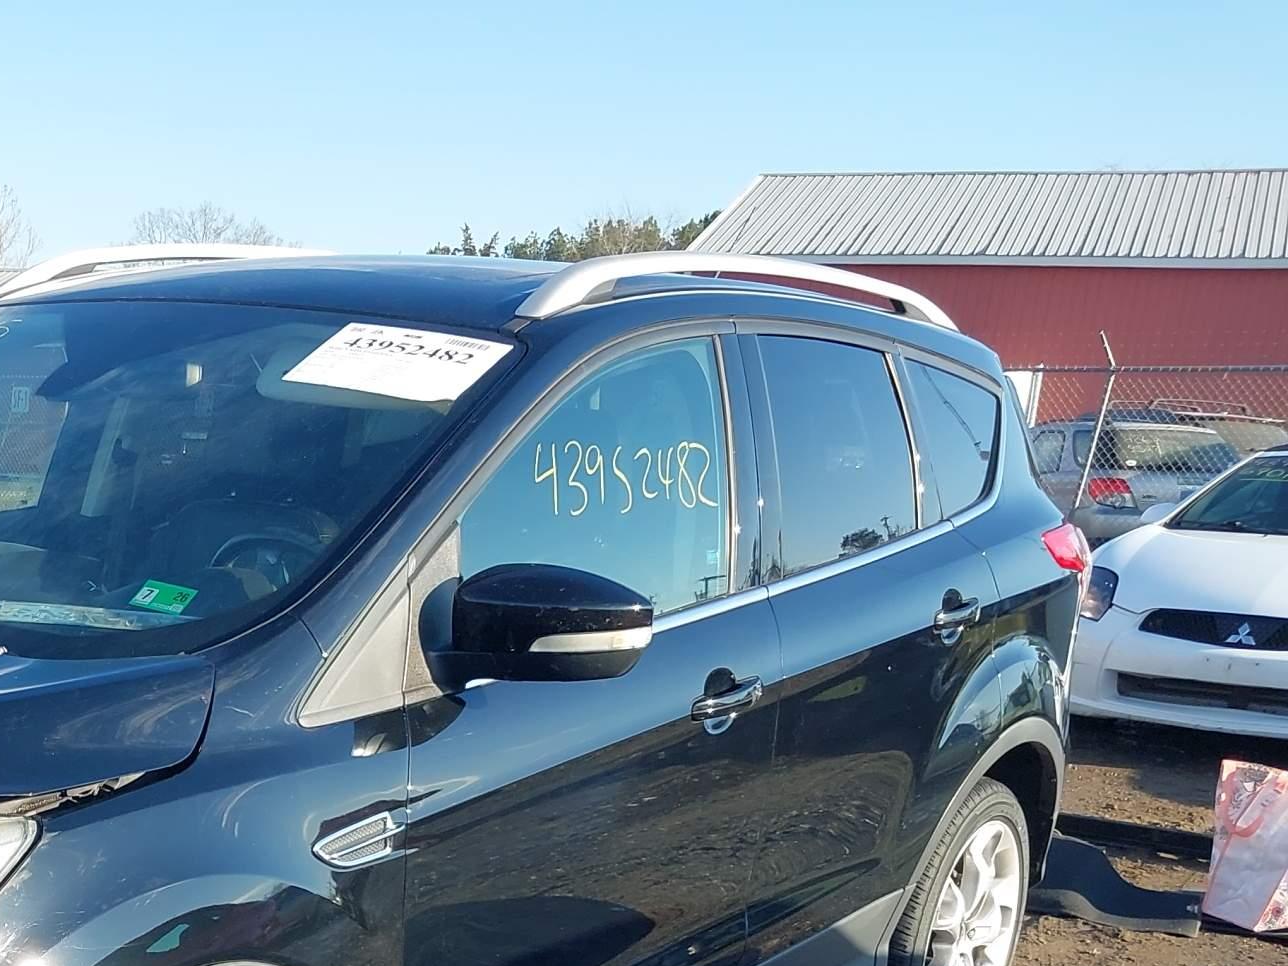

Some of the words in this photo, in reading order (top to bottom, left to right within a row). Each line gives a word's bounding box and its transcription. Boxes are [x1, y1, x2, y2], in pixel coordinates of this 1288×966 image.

[344, 337, 474, 365] 43952482
[534, 440, 718, 517] 43952482
[142, 589, 155, 600] 7
[173, 592, 190, 602] 26
